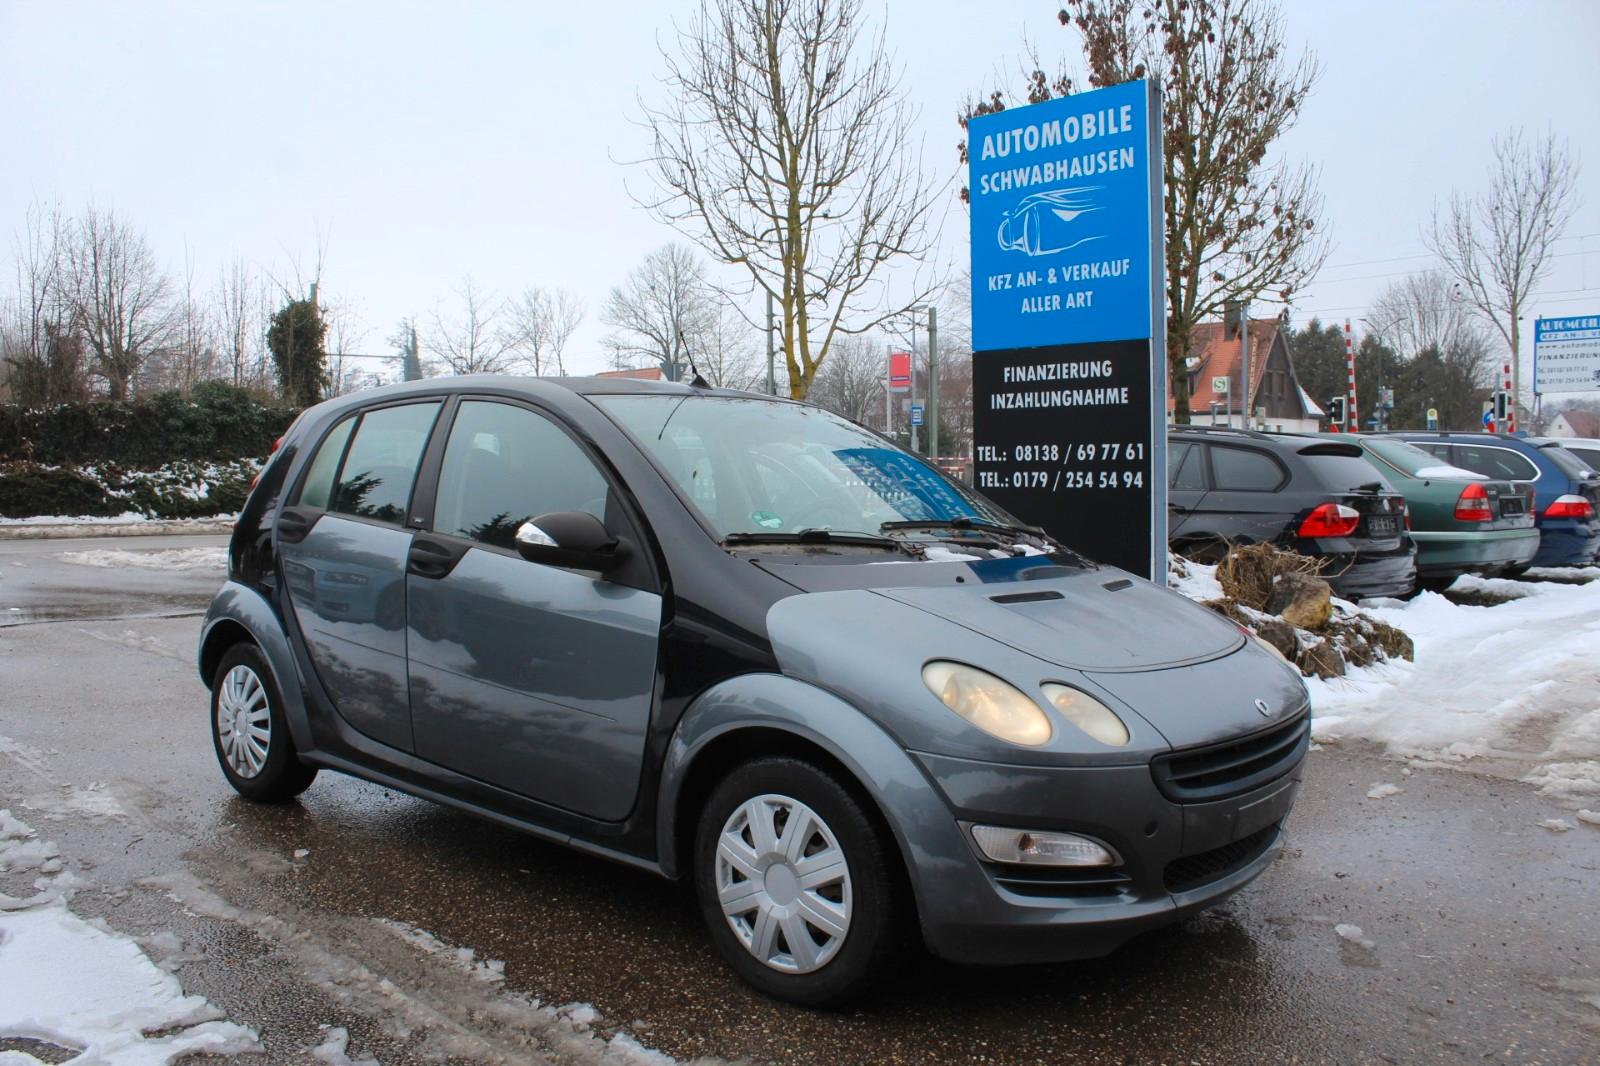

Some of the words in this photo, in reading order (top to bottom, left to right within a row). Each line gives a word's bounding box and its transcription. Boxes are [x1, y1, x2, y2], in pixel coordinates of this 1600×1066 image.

[981, 104, 1132, 161] AUTOMOBILE
[980, 147, 1134, 194] SCHWABHAUSEN
[988, 273, 1012, 291] KFZ
[1017, 271, 1042, 287] AN-
[1048, 268, 1057, 284] &
[1062, 258, 1130, 282] VERKAUF
[1021, 294, 1061, 314] ALLER
[1066, 291, 1093, 309] ART
[1539, 318, 1600, 331] AUTOMOBIL
[1538, 352, 1600, 360] FINANZIERUN
[1004, 360, 1113, 383] FINANZIERUNG
[991, 387, 1129, 410] INZAHLUNGNAHME
[977, 446, 1007, 462] TEL.:
[1015, 444, 1059, 462] 08138
[1063, 443, 1072, 465] /
[1077, 444, 1096, 461] 69
[1101, 443, 1121, 461] 77
[1125, 443, 1144, 460] 61
[979, 471, 1009, 488] TEL.:
[1013, 471, 1048, 488] 0179
[1052, 471, 1061, 492] /
[1066, 471, 1094, 488] 254
[1099, 471, 1118, 488] 54
[1123, 471, 1143, 488] 94
